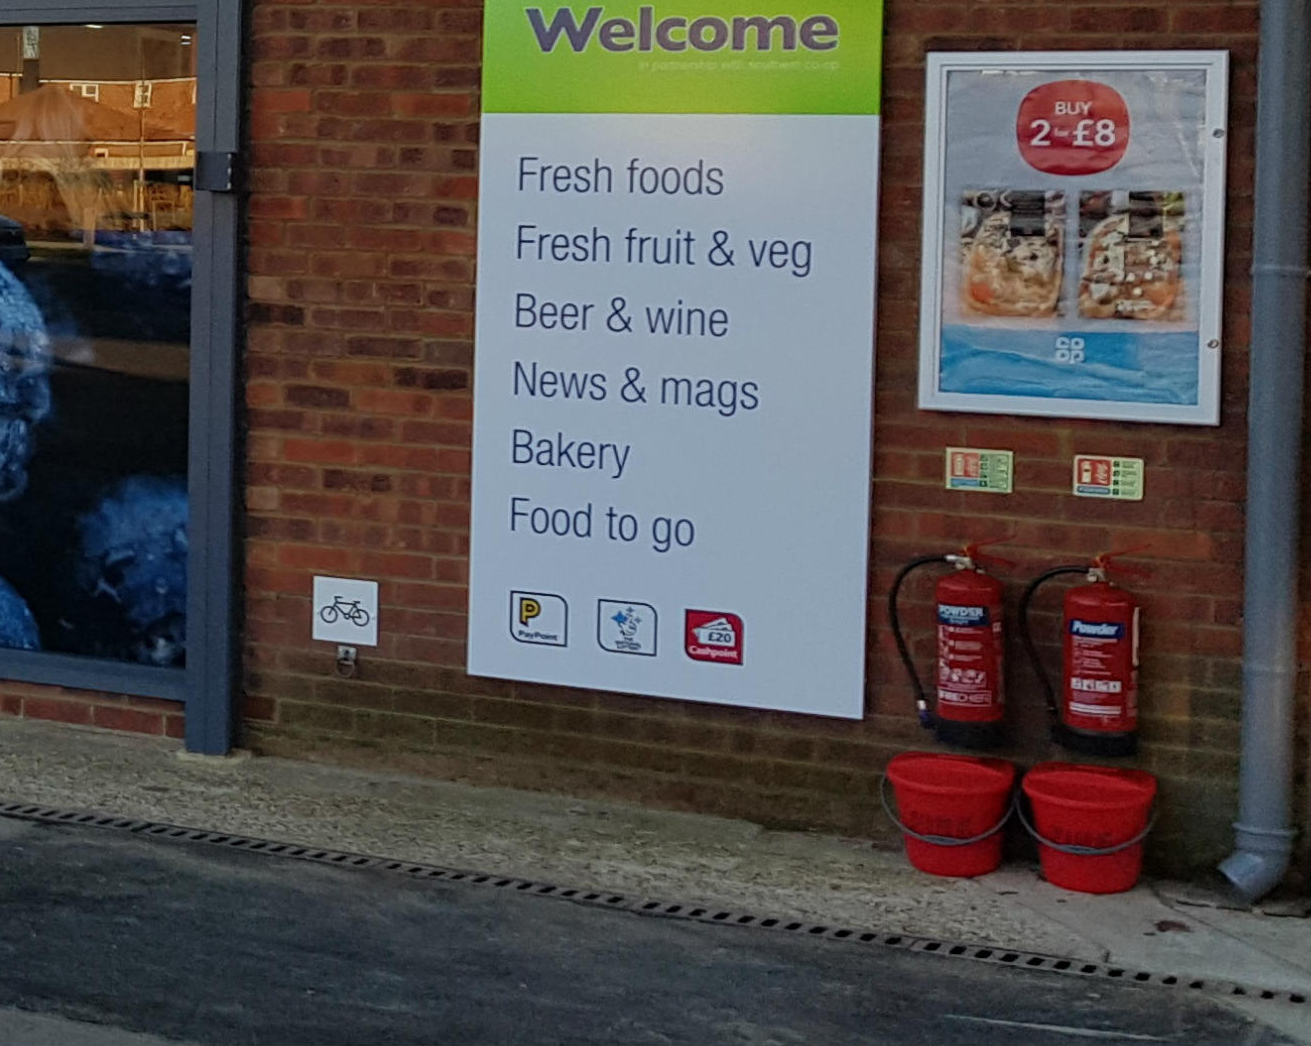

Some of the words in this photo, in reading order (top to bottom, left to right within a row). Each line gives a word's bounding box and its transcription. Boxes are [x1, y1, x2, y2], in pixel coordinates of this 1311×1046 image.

[525, 5, 840, 53] Welcome
[1054, 101, 1093, 116] BUY
[1030, 119, 1052, 146] 2
[1072, 118, 1116, 147] £8
[518, 157, 613, 193] Fresh
[627, 158, 725, 196] foods
[517, 224, 611, 262] Fresh
[625, 227, 696, 265] fruit
[707, 230, 735, 267] &
[748, 238, 812, 278] veg
[515, 293, 595, 331] Beer
[606, 296, 633, 333] &
[646, 299, 729, 337] wine
[513, 361, 607, 401] News
[620, 366, 647, 404] &
[661, 376, 759, 417] mags
[512, 429, 630, 479] Bakery
[510, 497, 593, 538] Food
[606, 506, 639, 542] to
[652, 515, 695, 553] go
[688, 646, 739, 659] Cashpoint
[707, 632, 732, 644] £20
